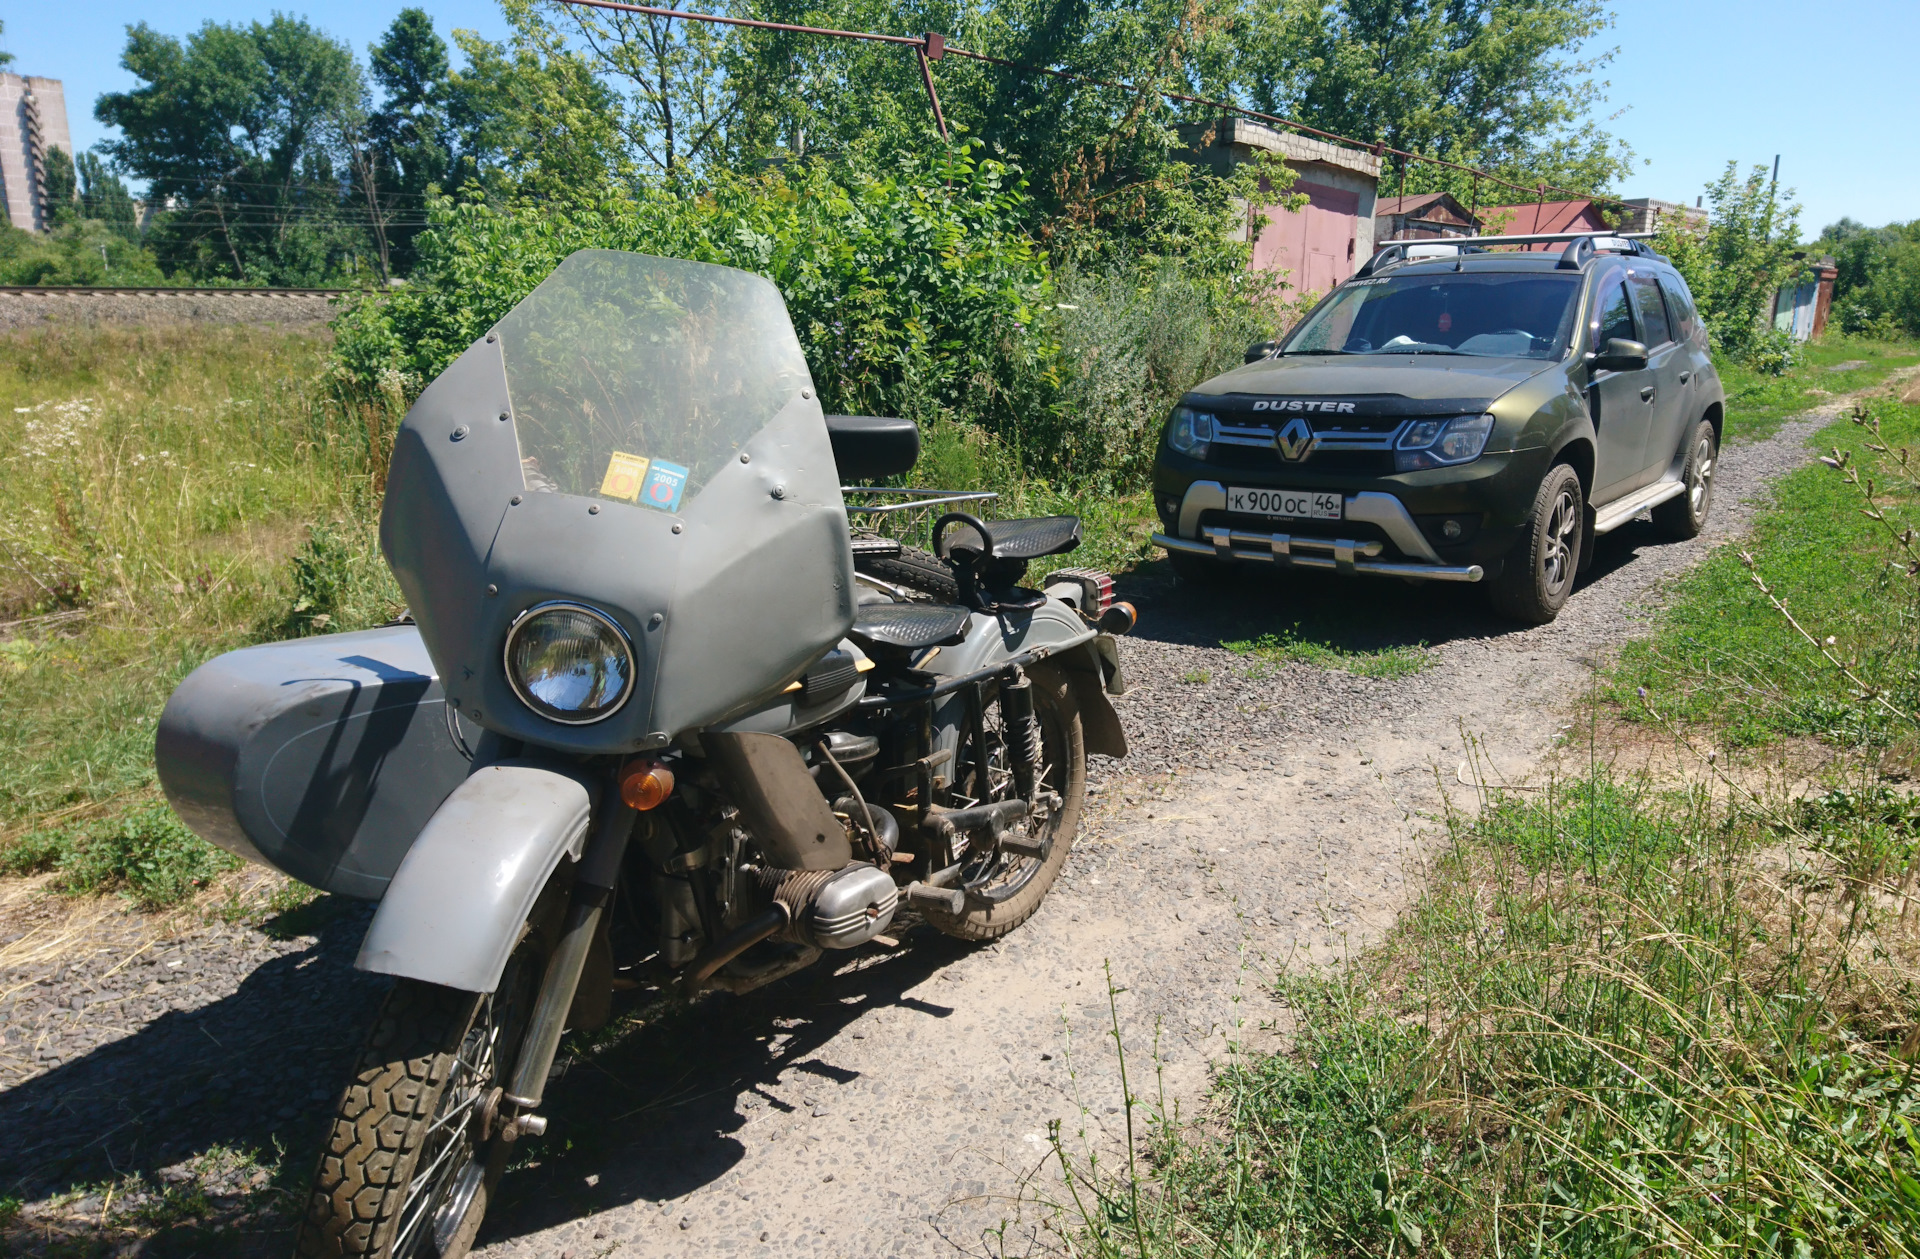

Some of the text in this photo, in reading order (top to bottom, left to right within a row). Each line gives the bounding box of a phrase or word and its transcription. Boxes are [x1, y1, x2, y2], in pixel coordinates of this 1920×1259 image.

[1252, 400, 1356, 414] DUSTER
[653, 472, 679, 487] 2005
[1314, 494, 1334, 511] 46
[1313, 509, 1328, 517] RUS
